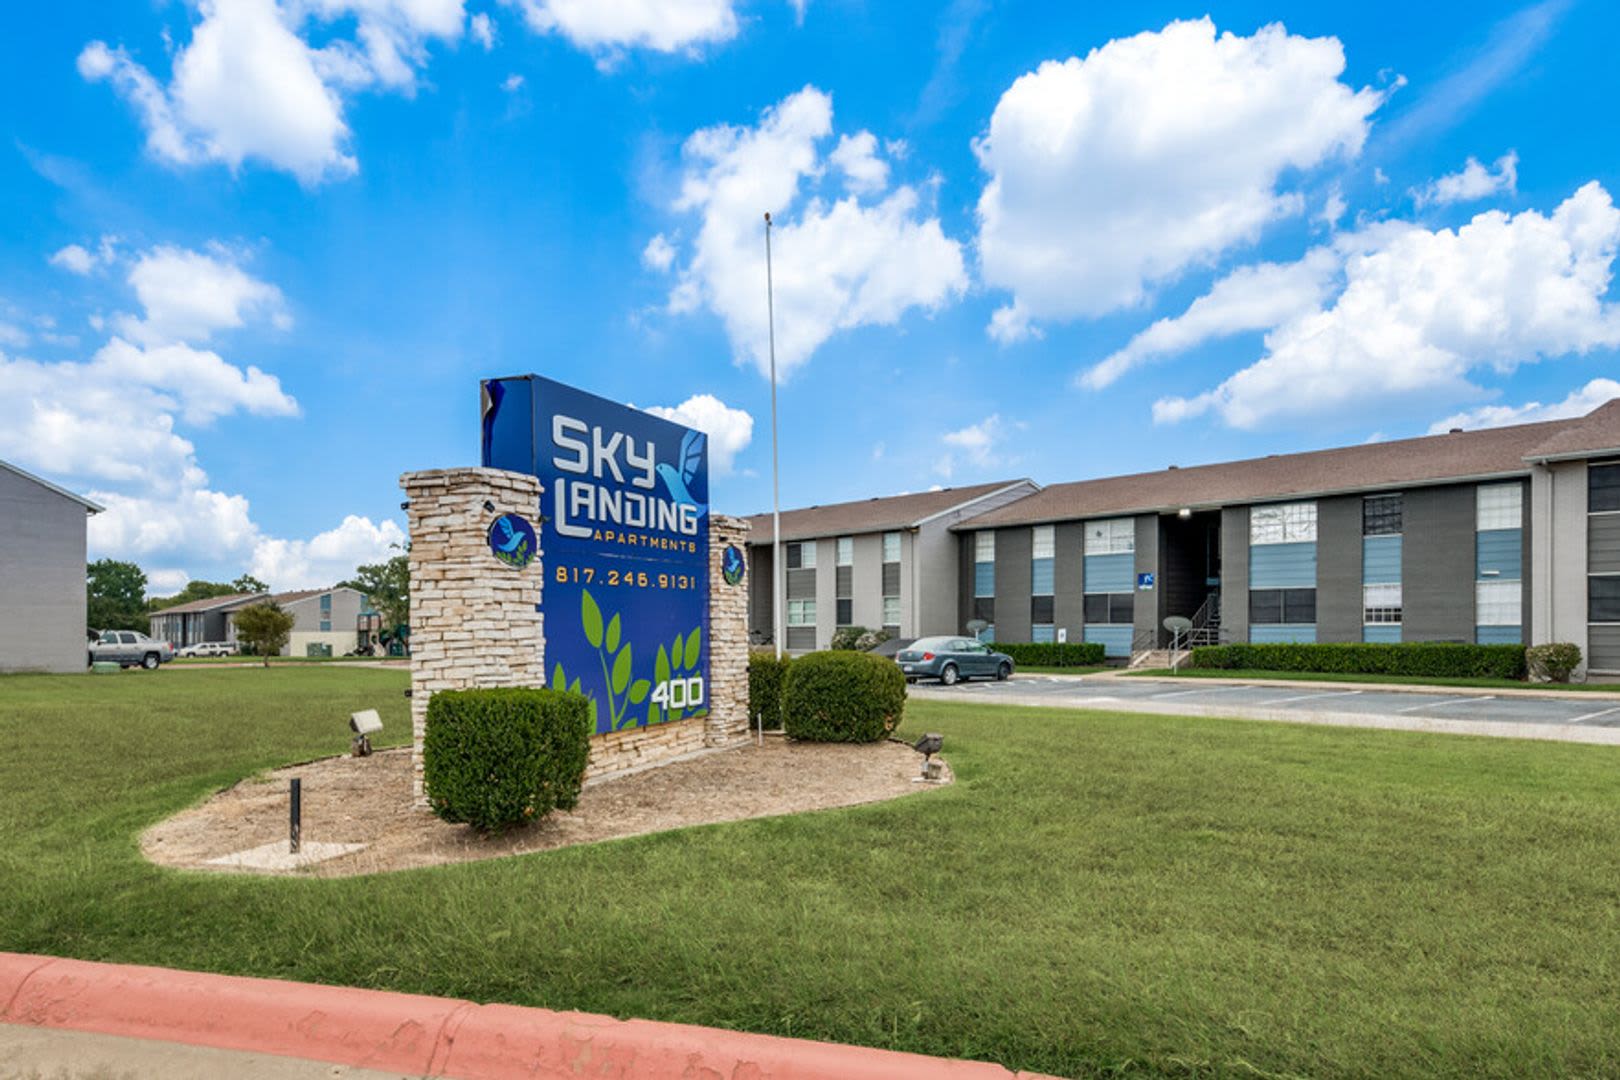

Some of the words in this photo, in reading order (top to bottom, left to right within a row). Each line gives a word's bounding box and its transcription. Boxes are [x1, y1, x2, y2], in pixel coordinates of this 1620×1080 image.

[553, 414, 655, 488] SKY
[555, 478, 698, 538] LANDING
[594, 529, 696, 553] APARTMENTS
[556, 566, 696, 590] 817.246.9131
[651, 677, 703, 710] 400
